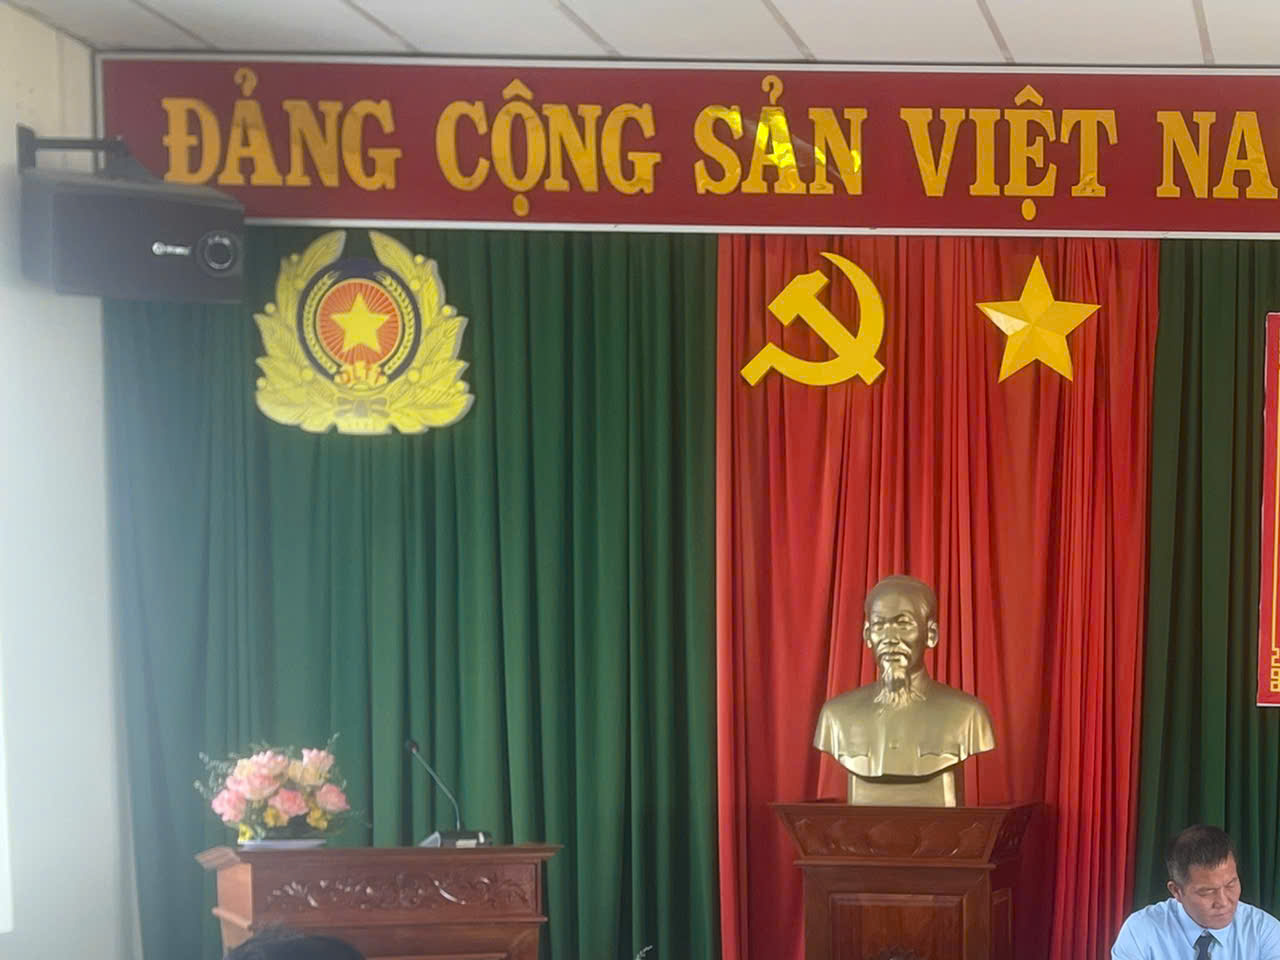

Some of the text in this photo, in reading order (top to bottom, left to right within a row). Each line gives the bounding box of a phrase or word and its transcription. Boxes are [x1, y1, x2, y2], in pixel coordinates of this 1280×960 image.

[162, 68, 402, 191] ĐẢNG
[435, 78, 662, 217] CỘNG
[693, 75, 868, 196] SẢN
[900, 85, 1118, 221] VIỆT
